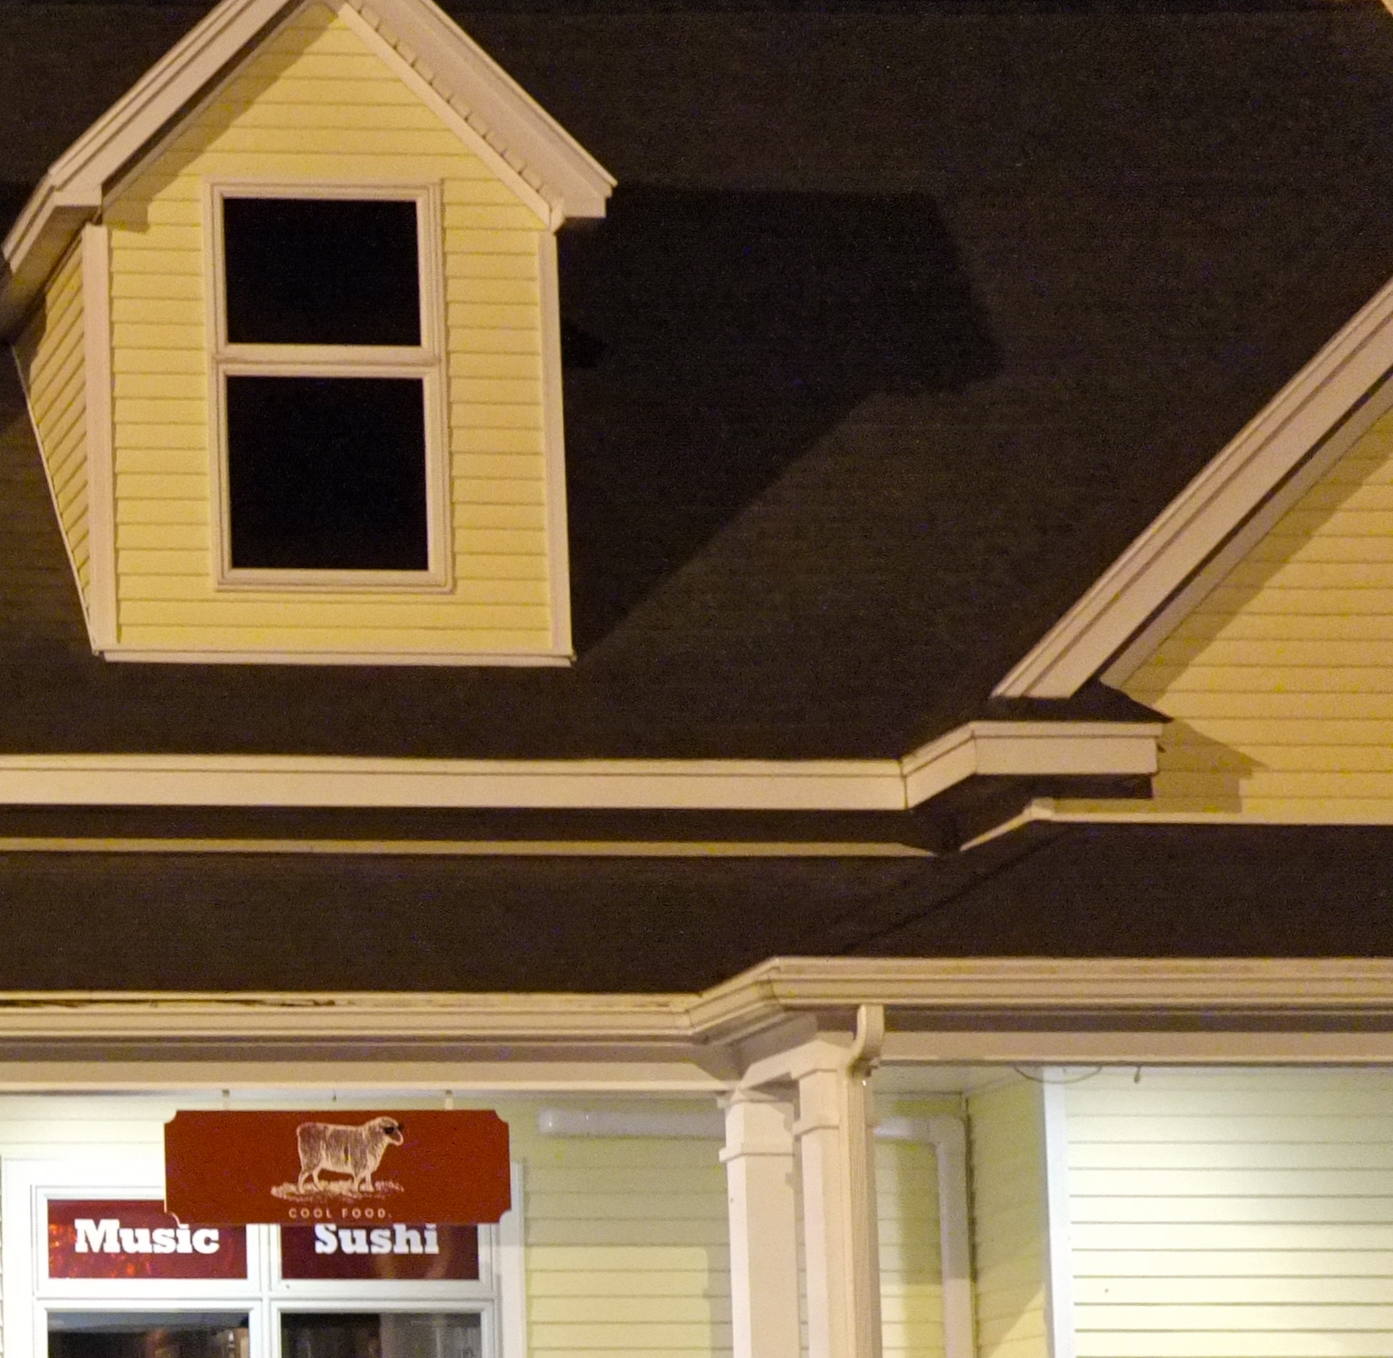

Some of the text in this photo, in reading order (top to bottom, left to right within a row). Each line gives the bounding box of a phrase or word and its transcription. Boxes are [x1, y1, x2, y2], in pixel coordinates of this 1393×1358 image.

[288, 1207, 332, 1219] COOL
[73, 1218, 220, 1255] Music
[314, 1223, 440, 1255] Sushi
